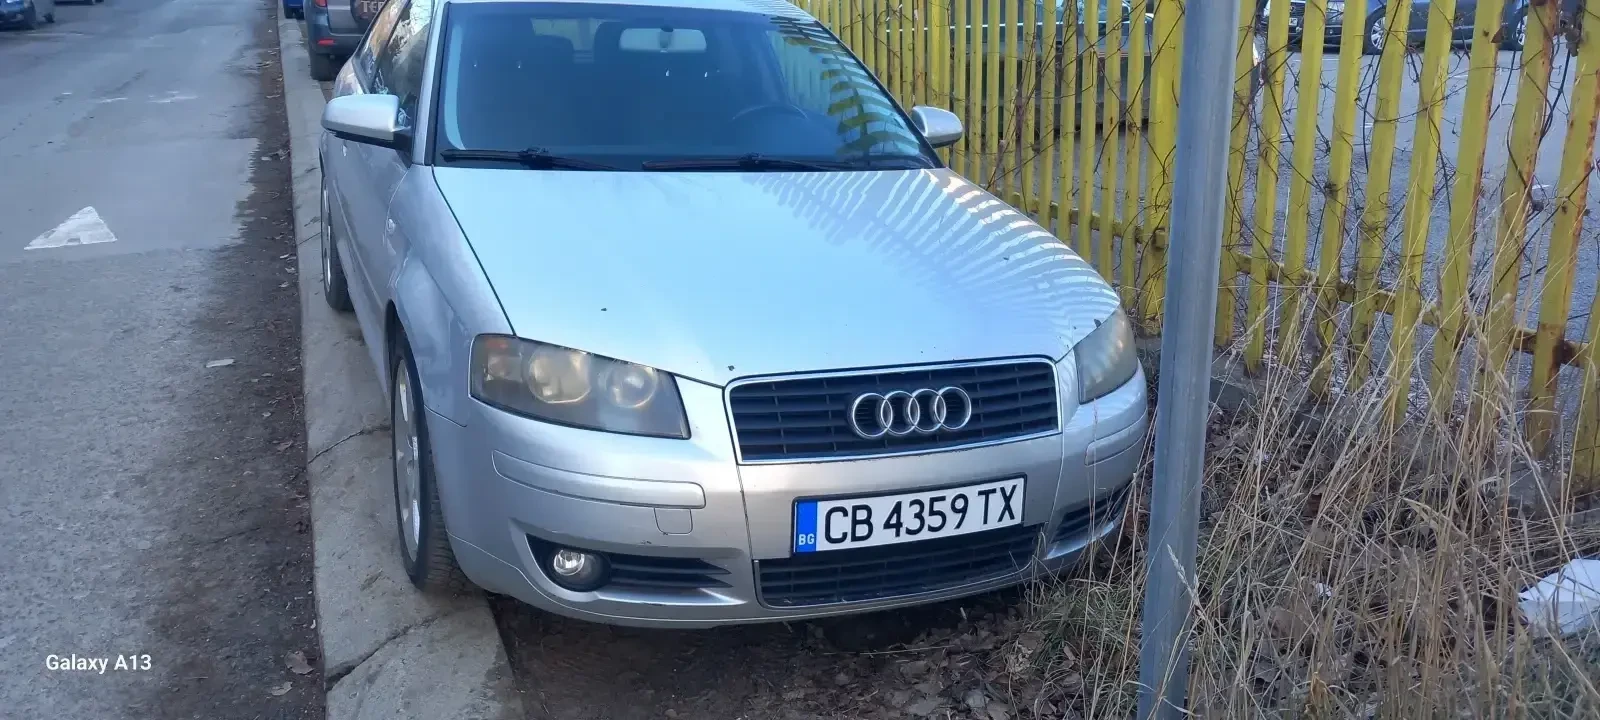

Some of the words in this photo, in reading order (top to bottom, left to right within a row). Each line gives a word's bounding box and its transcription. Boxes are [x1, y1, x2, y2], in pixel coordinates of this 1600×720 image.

[824, 504, 874, 544] CB
[882, 493, 969, 538] 4359
[977, 484, 1018, 525] TX
[798, 533, 815, 546] BG
